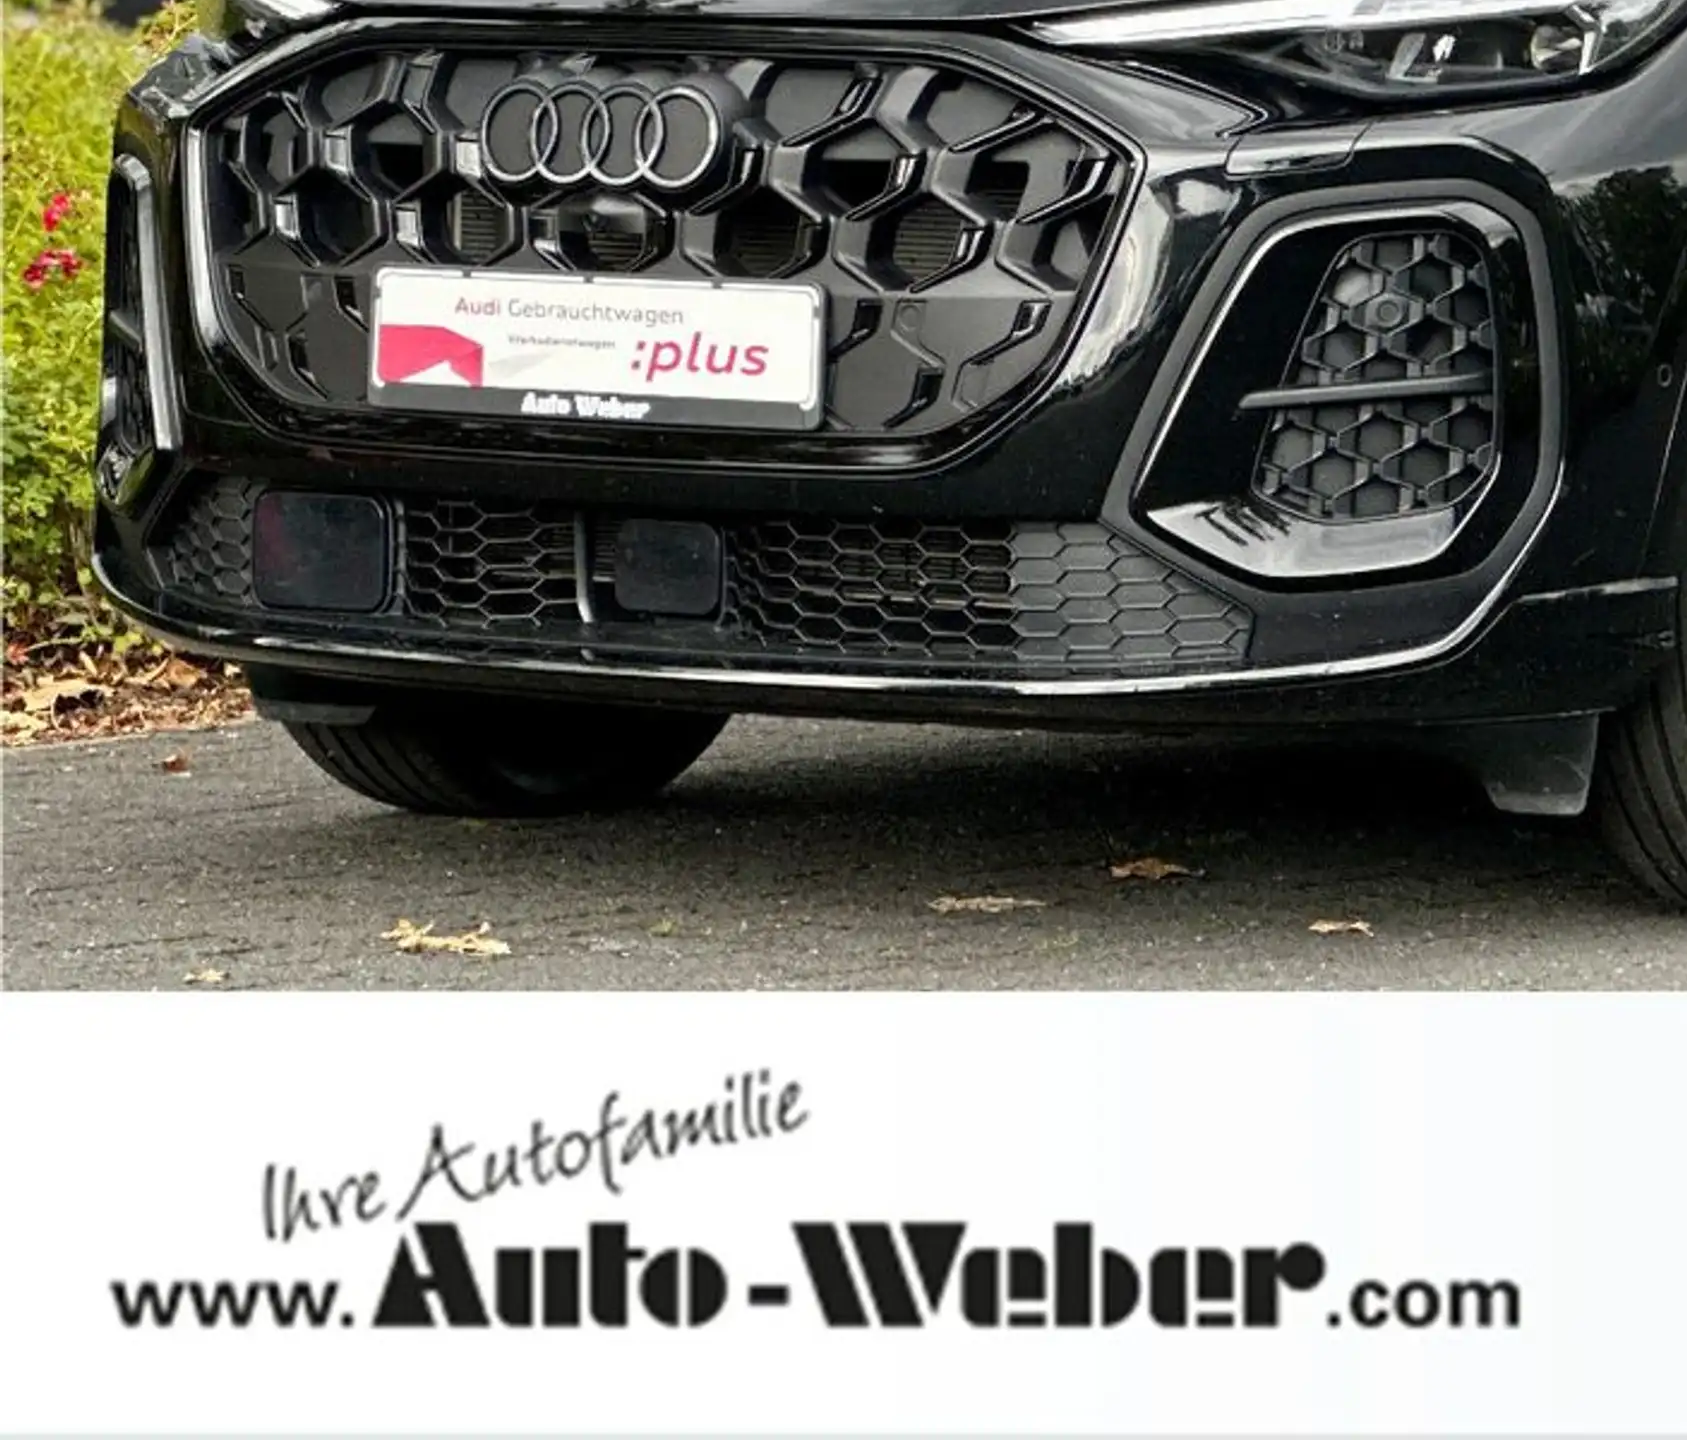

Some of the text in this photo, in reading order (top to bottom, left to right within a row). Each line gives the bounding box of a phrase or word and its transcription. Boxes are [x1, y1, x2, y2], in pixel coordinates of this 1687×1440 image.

[454, 296, 685, 328] Audi Gebrauchtwagen
[631, 330, 770, 383] :plus
[520, 391, 652, 420] Auto Weber
